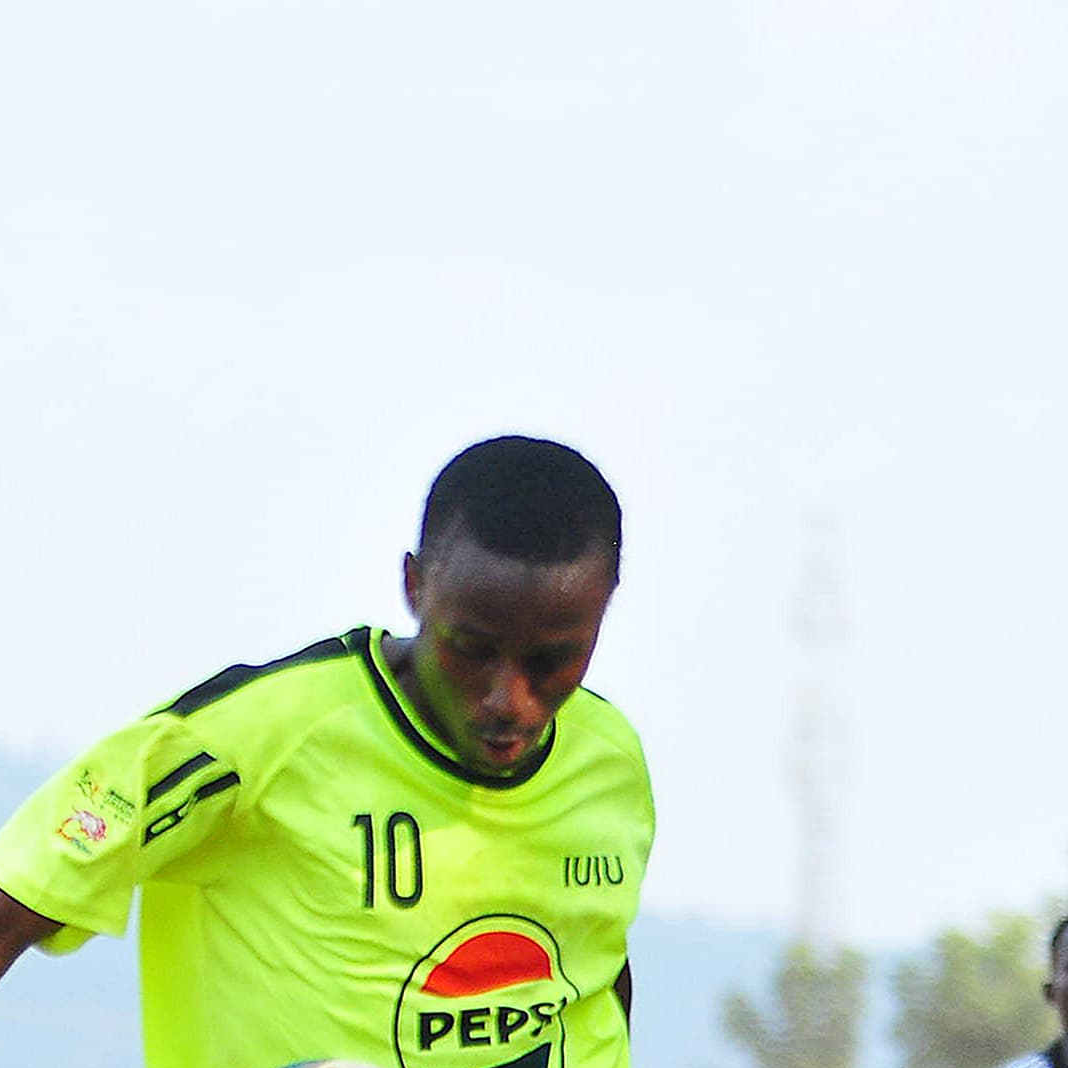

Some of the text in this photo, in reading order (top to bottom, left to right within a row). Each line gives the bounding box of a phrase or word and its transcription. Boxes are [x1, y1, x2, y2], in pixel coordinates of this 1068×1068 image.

[353, 812, 423, 909] 10
[564, 856, 624, 887] IUIU
[419, 998, 567, 1050] PEPS
